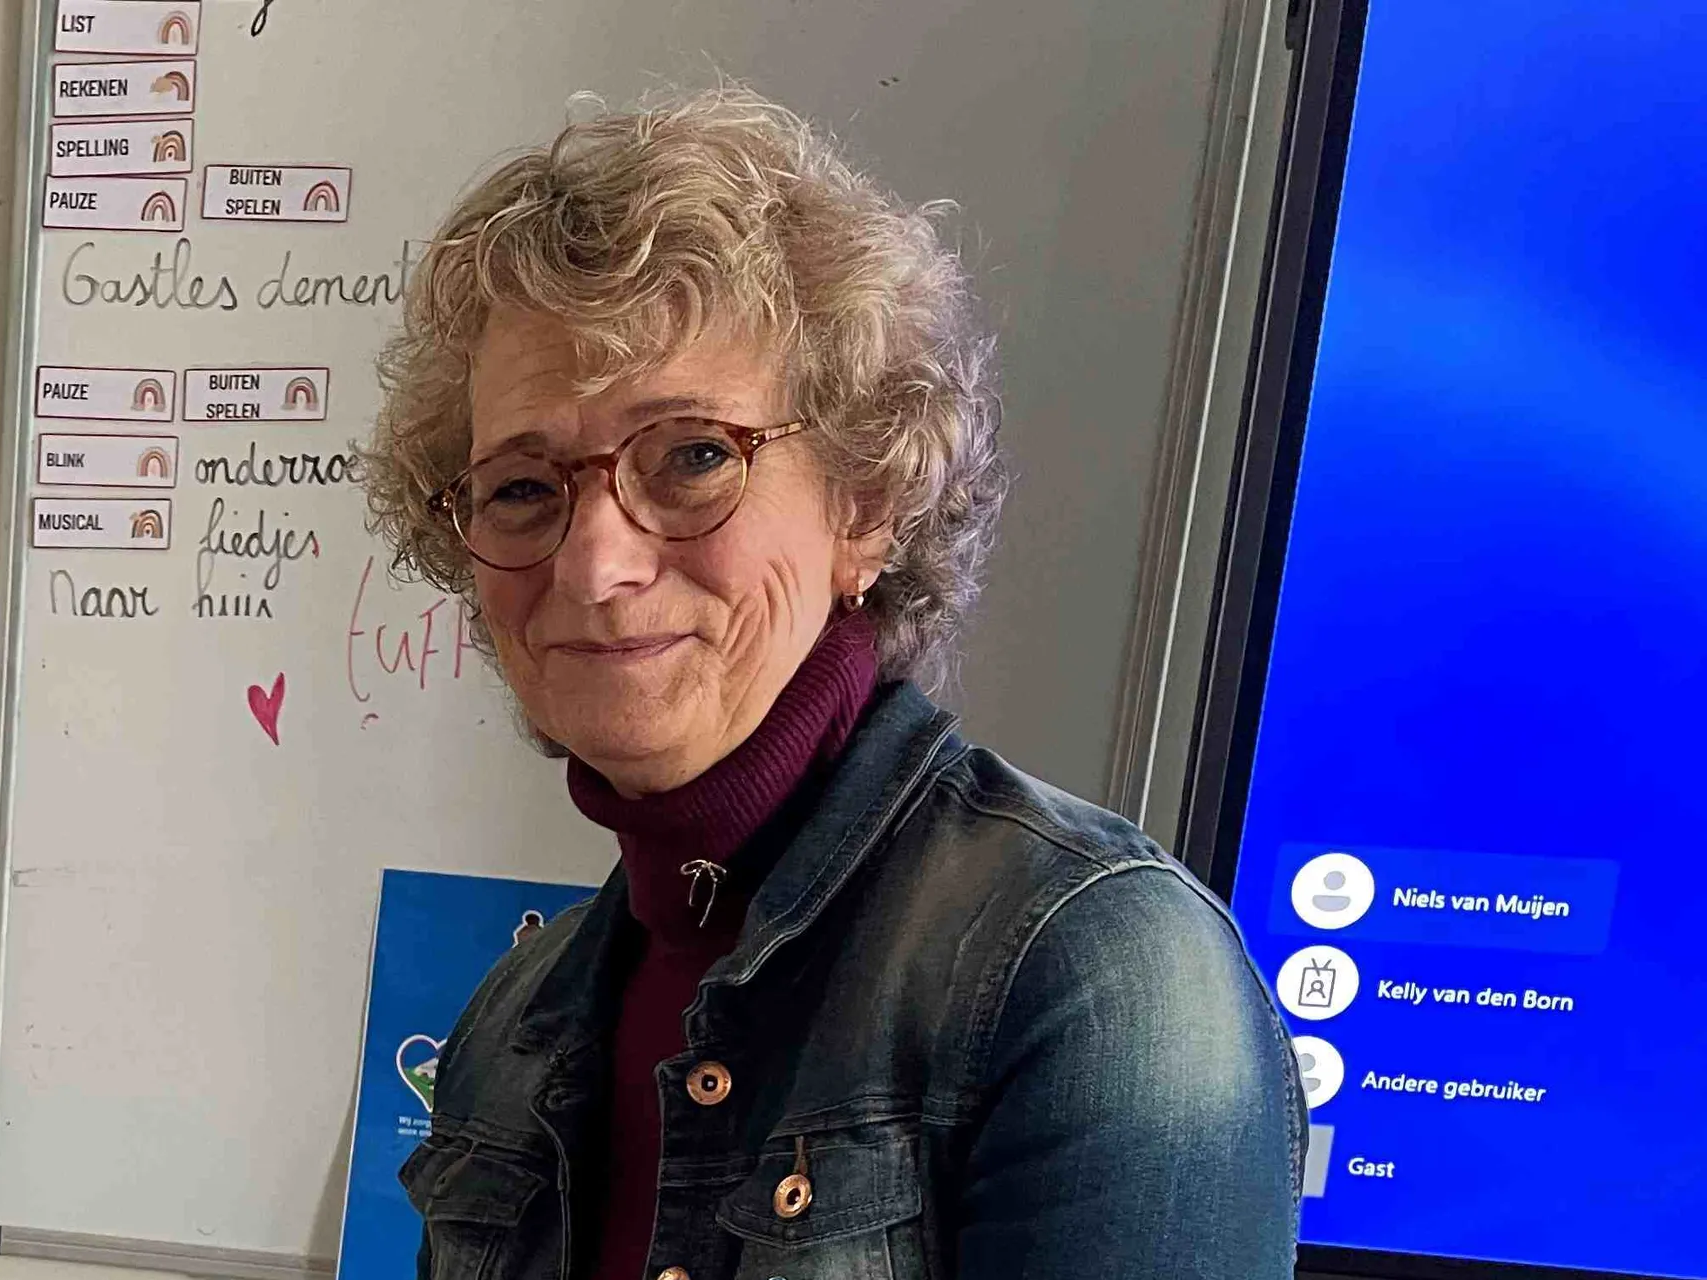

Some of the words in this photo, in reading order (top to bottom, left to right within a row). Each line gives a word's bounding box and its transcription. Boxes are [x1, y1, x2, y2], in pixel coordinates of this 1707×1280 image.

[61, 15, 95, 34] LIST
[59, 79, 128, 98] REKENEN
[56, 139, 129, 159] SPELLING
[229, 169, 282, 187] BUITEN
[50, 192, 97, 211] PAUZE
[225, 199, 282, 217] SPELEN
[62, 238, 238, 310] Gastles
[43, 383, 89, 401] PAUZE
[209, 374, 260, 391] BUITEN
[206, 403, 261, 419] SPELEN
[46, 451, 85, 468] BLINK
[38, 514, 103, 531] MUSICAL
[1393, 888, 1445, 909] Niels
[1451, 895, 1489, 912] van
[1495, 894, 1570, 920] Muijen
[1378, 979, 1428, 1005] Kelly
[1433, 989, 1470, 1005] van
[1476, 988, 1517, 1007] den
[1523, 991, 1574, 1012] Born
[1361, 1072, 1438, 1094] Andere
[1443, 1076, 1547, 1104] gebruiker
[1348, 1158, 1395, 1179] Gast
